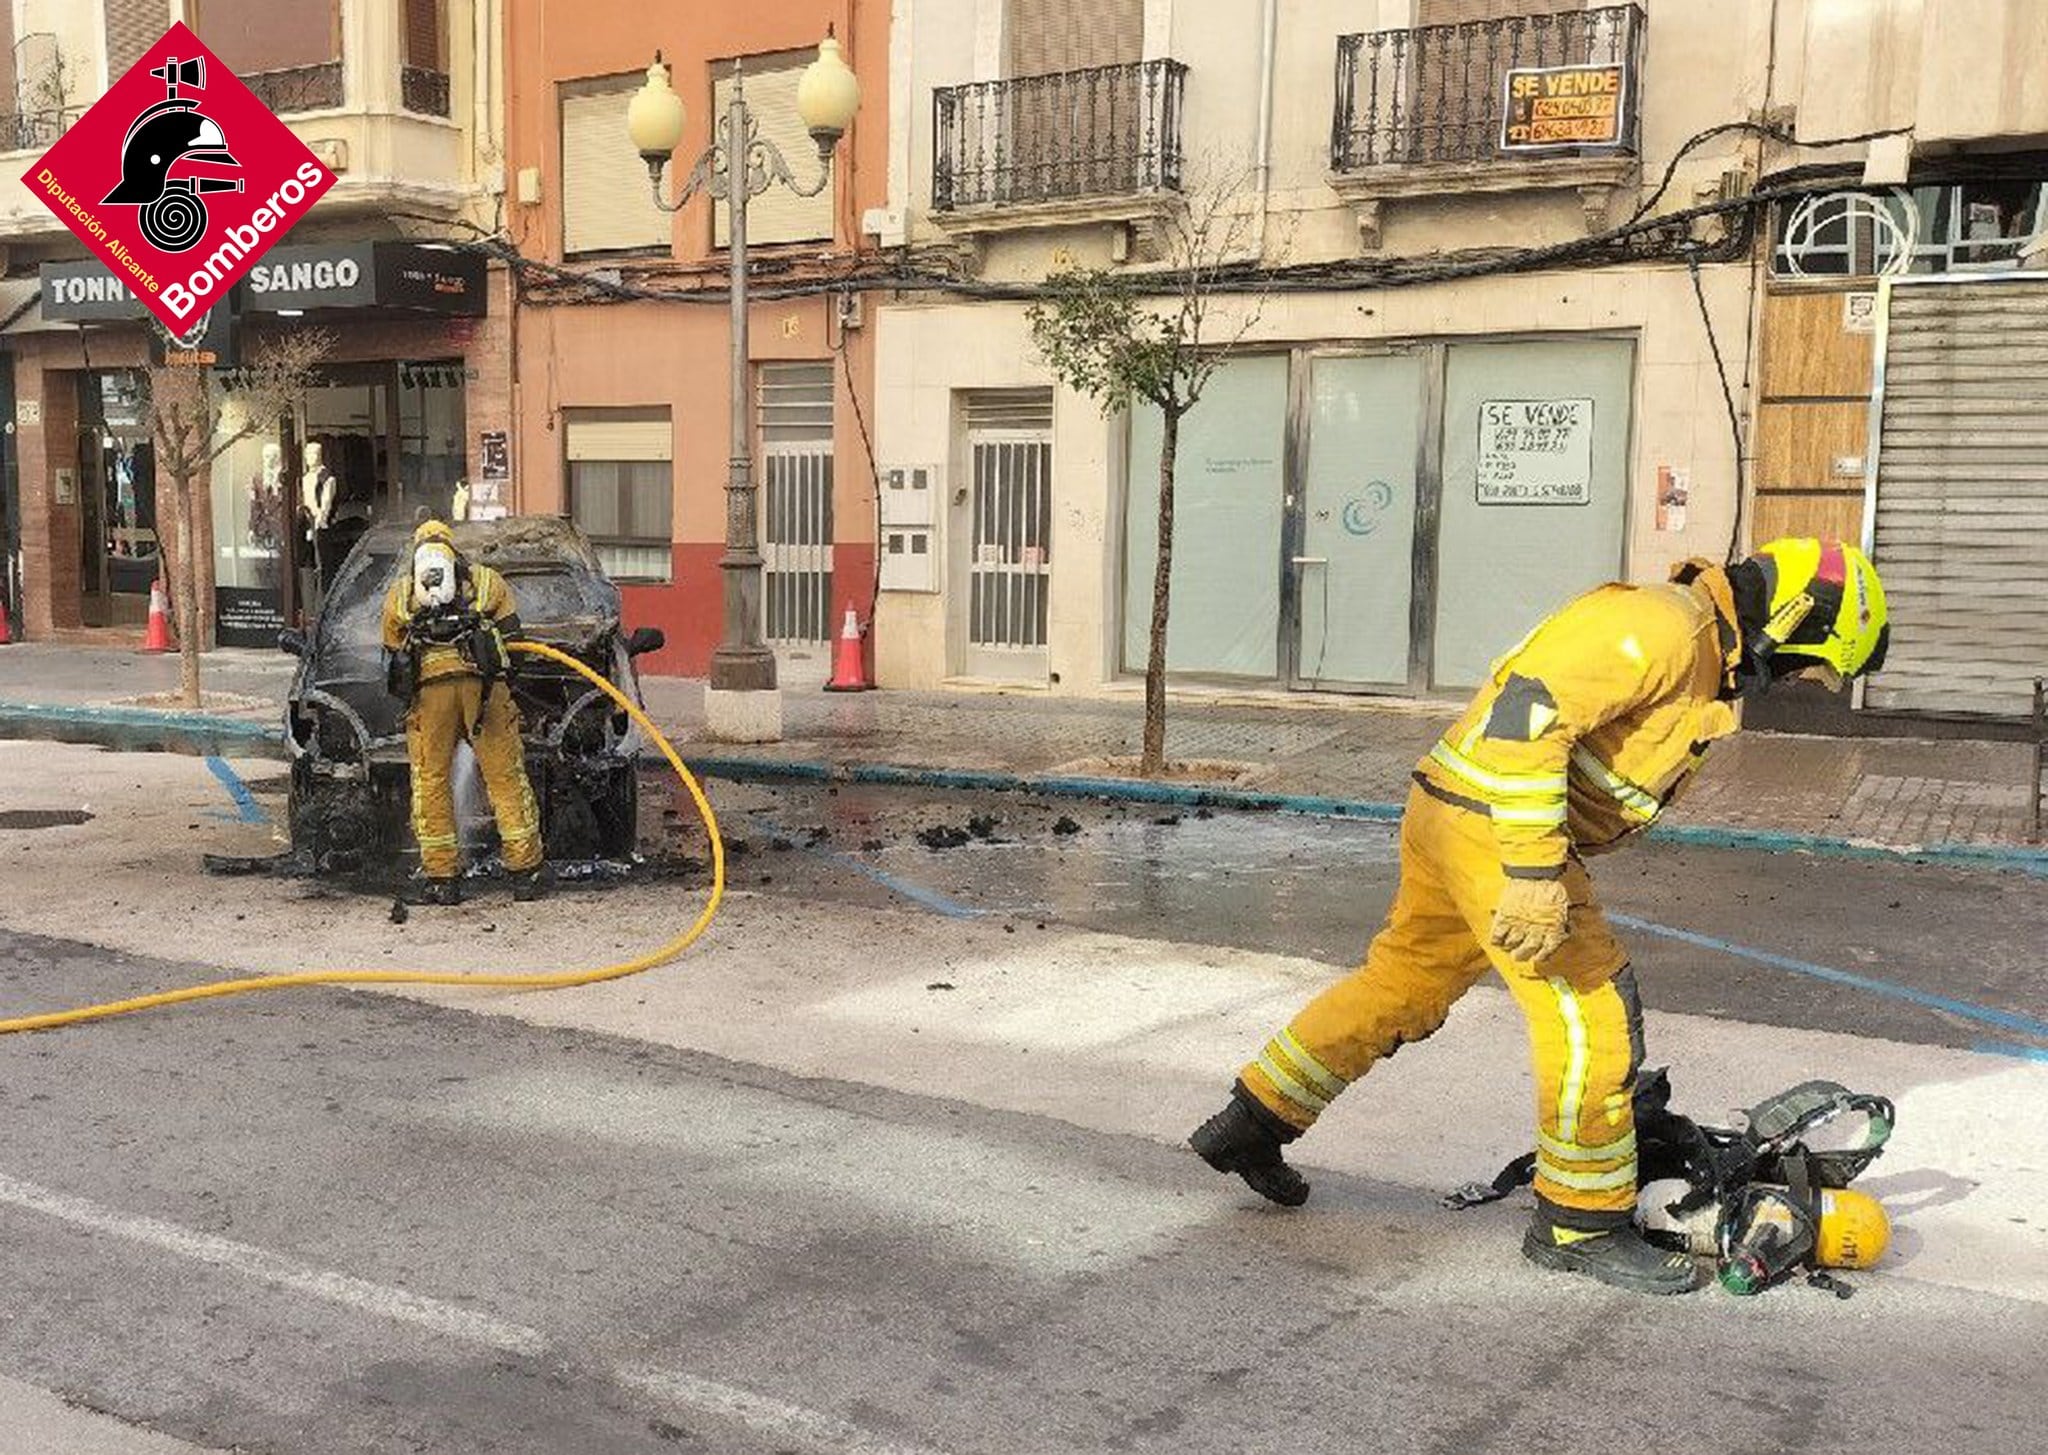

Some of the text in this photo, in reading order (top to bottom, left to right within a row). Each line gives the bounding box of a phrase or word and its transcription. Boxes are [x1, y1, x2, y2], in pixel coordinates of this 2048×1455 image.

[1511, 70, 1618, 99] SE VENDE
[51, 258, 360, 304] TONN SANGO
[1487, 403, 1580, 426] SE VENDE
